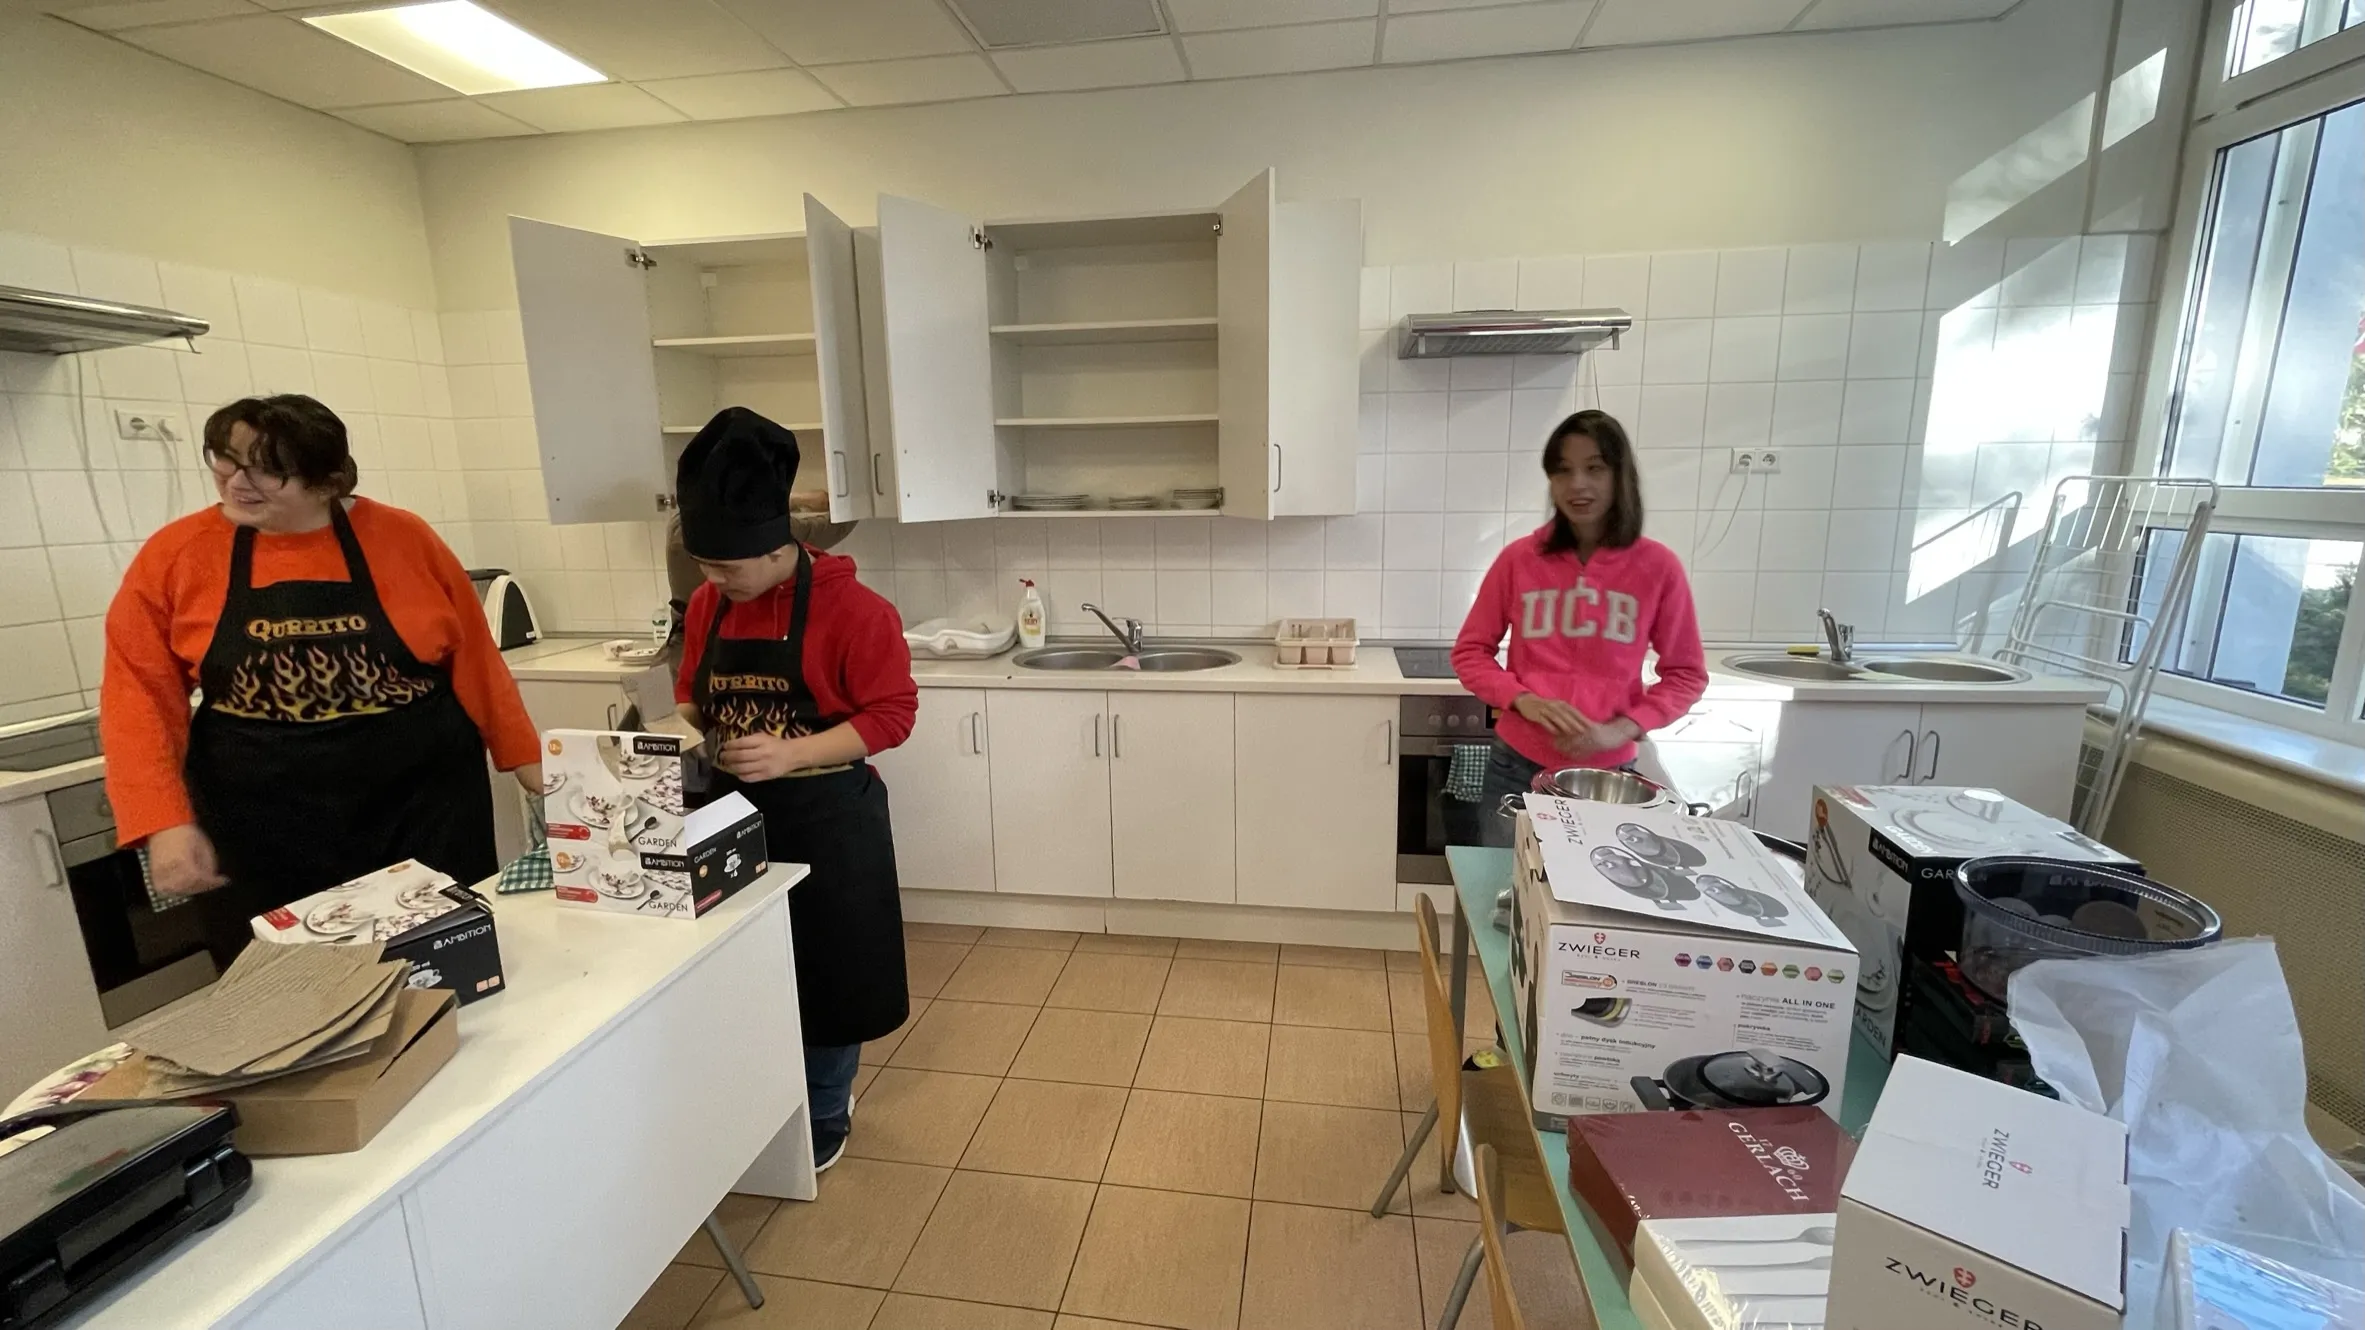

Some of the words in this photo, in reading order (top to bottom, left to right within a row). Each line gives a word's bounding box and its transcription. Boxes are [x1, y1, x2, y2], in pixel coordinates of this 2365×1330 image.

[1521, 582, 1639, 644] UCB
[643, 742, 676, 752] AMBITION
[1554, 799, 1583, 845] ZWIEGER
[638, 836, 677, 848] GARDEN
[651, 858, 685, 868] AMBITION
[648, 900, 688, 912] GARDEN
[443, 923, 492, 947] AMBITION
[1558, 942, 1641, 959] ZWIEGER
[1782, 997, 1800, 1006] ALL
[1802, 999, 1813, 1007] IN
[1815, 1001, 1836, 1010] ONE
[1854, 1006, 1887, 1048] ARDEN
[1728, 1122, 1810, 1201] GERLACH
[1982, 1128, 2010, 1189] ZWIEGER
